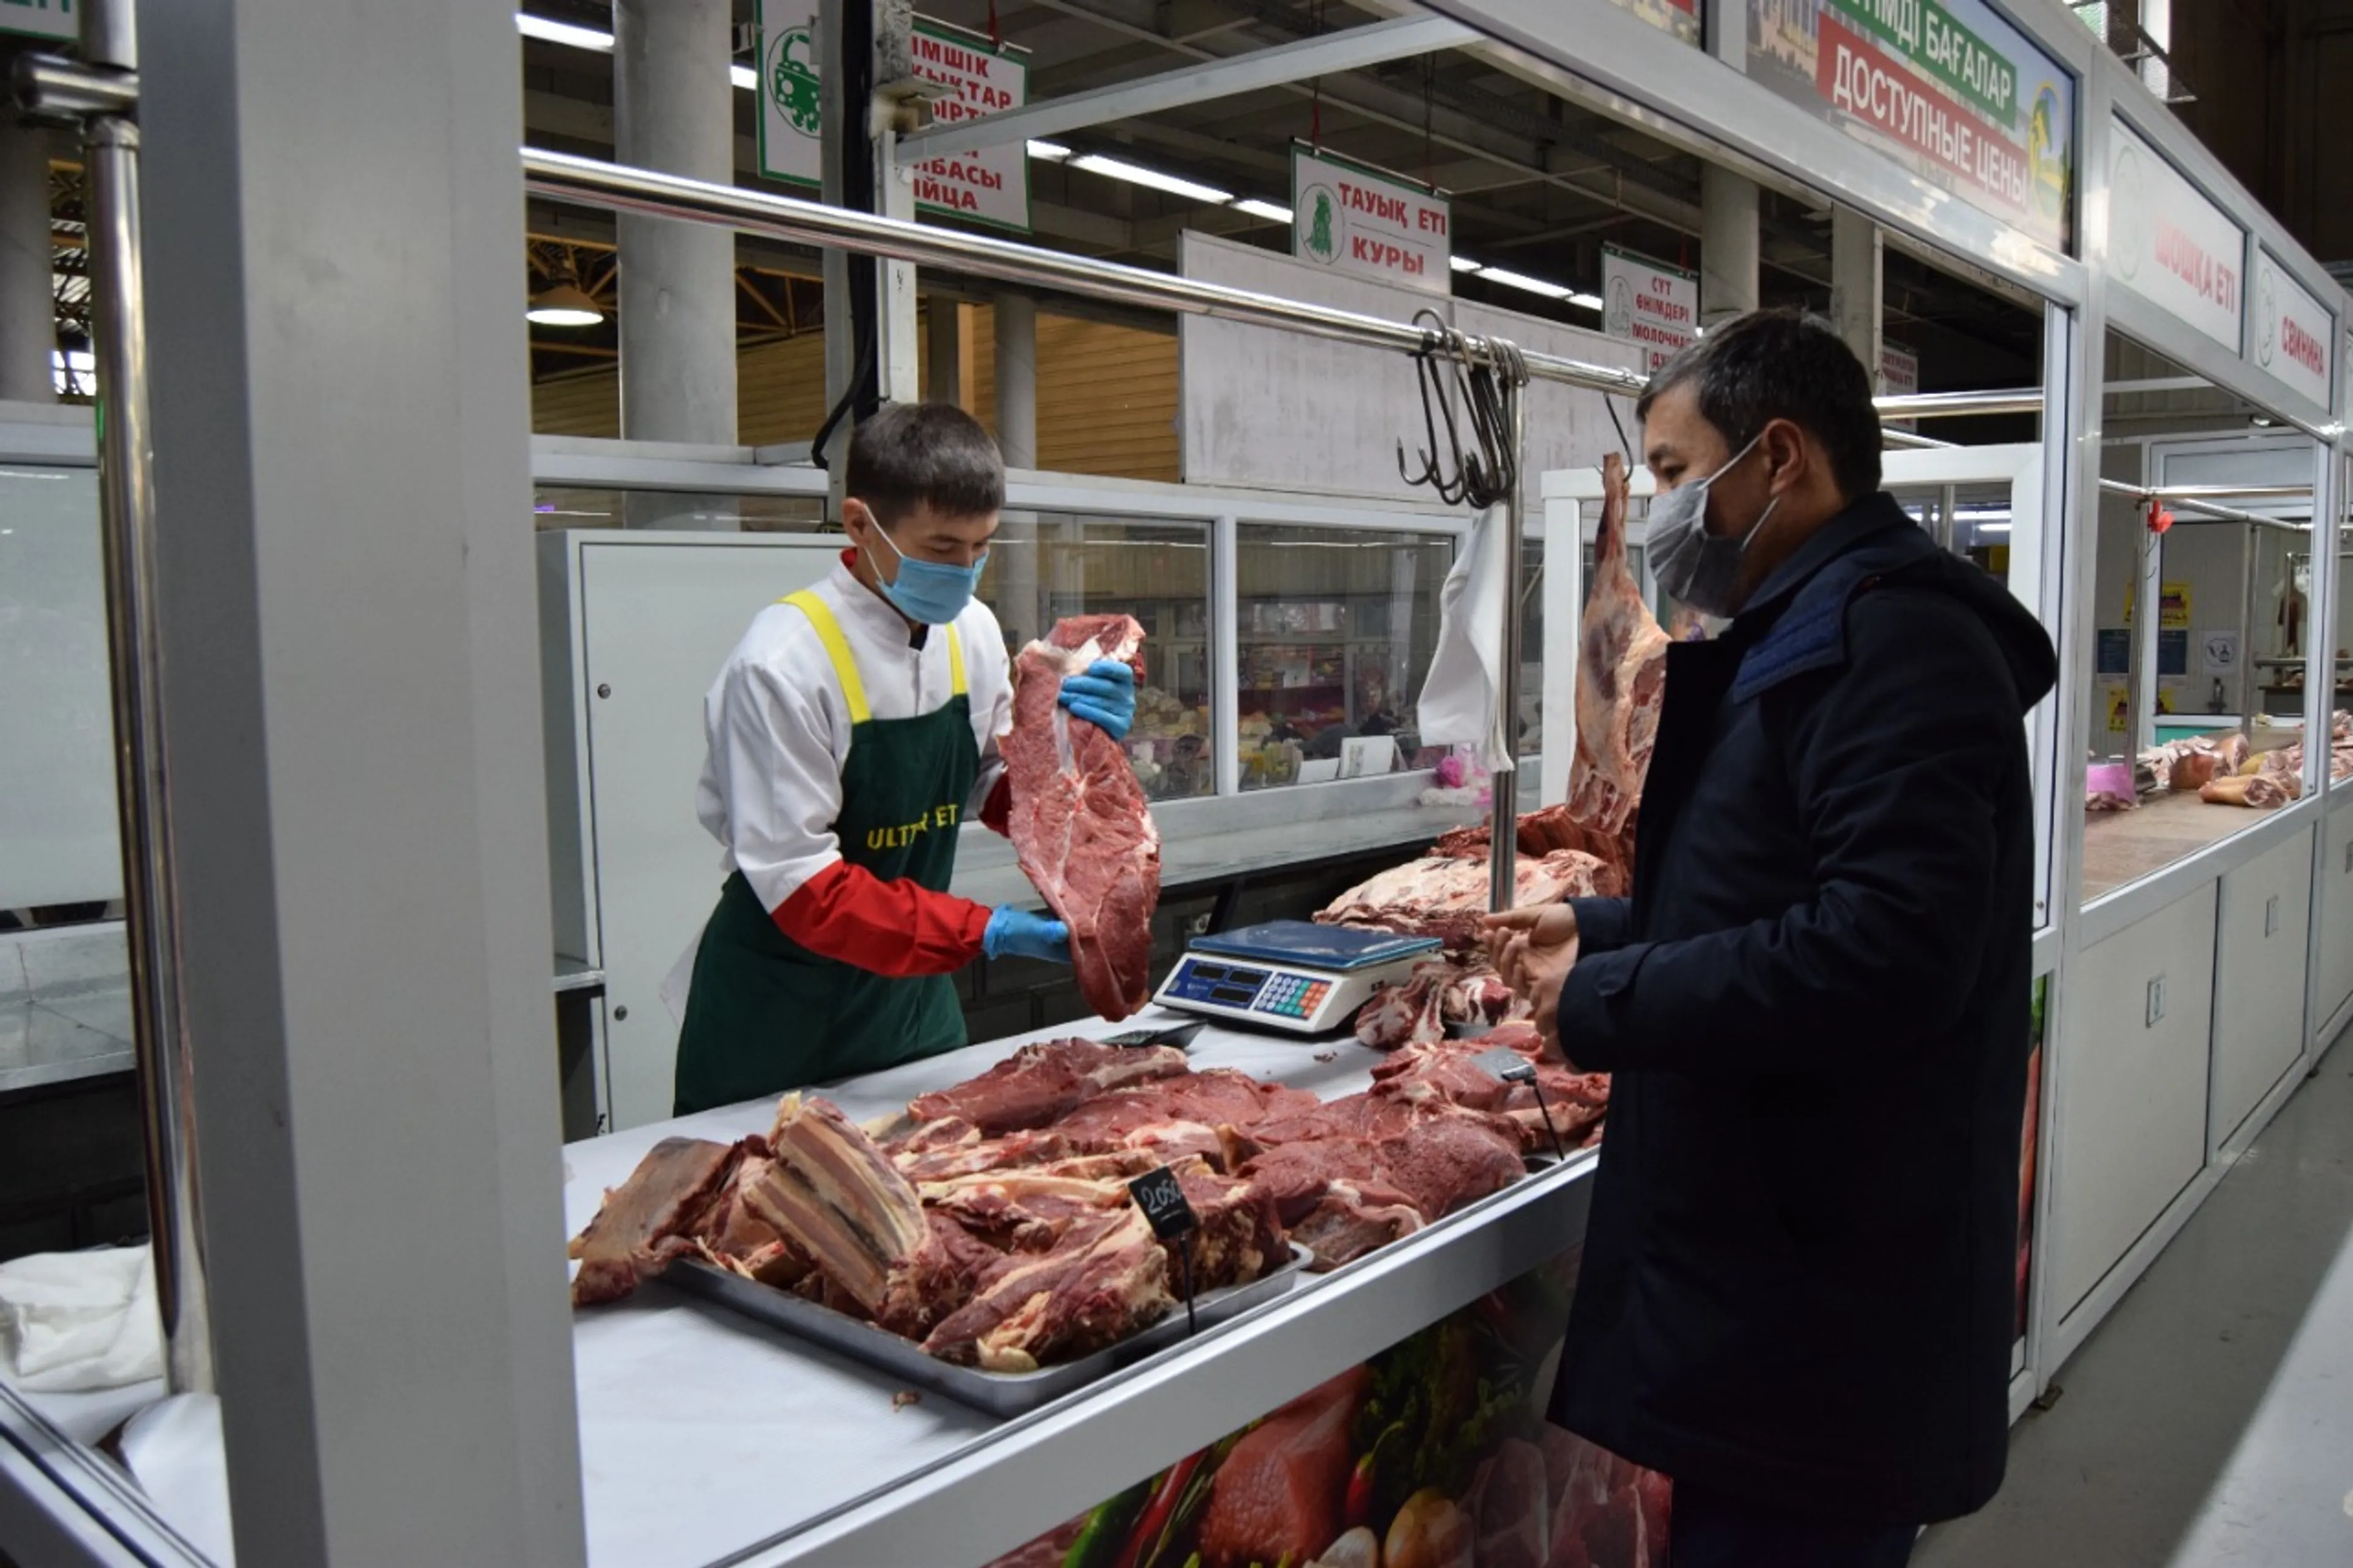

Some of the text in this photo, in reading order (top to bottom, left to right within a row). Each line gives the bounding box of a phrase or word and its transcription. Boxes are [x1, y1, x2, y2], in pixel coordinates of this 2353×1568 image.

[912, 36, 989, 78] ІМШІК
[1926, 9, 2011, 110] БАҒАЛАР
[1833, 44, 2027, 206] ДОСТУПНЫЕ ЦЕНЫ
[1338, 182, 1446, 236] ТАУЫҚ ЕТІ
[1353, 235, 1424, 275] КУРЫ
[2216, 262, 2235, 315] ЕТІ
[2282, 316, 2325, 379] СВИНИНА
[936, 803, 958, 828] ET
